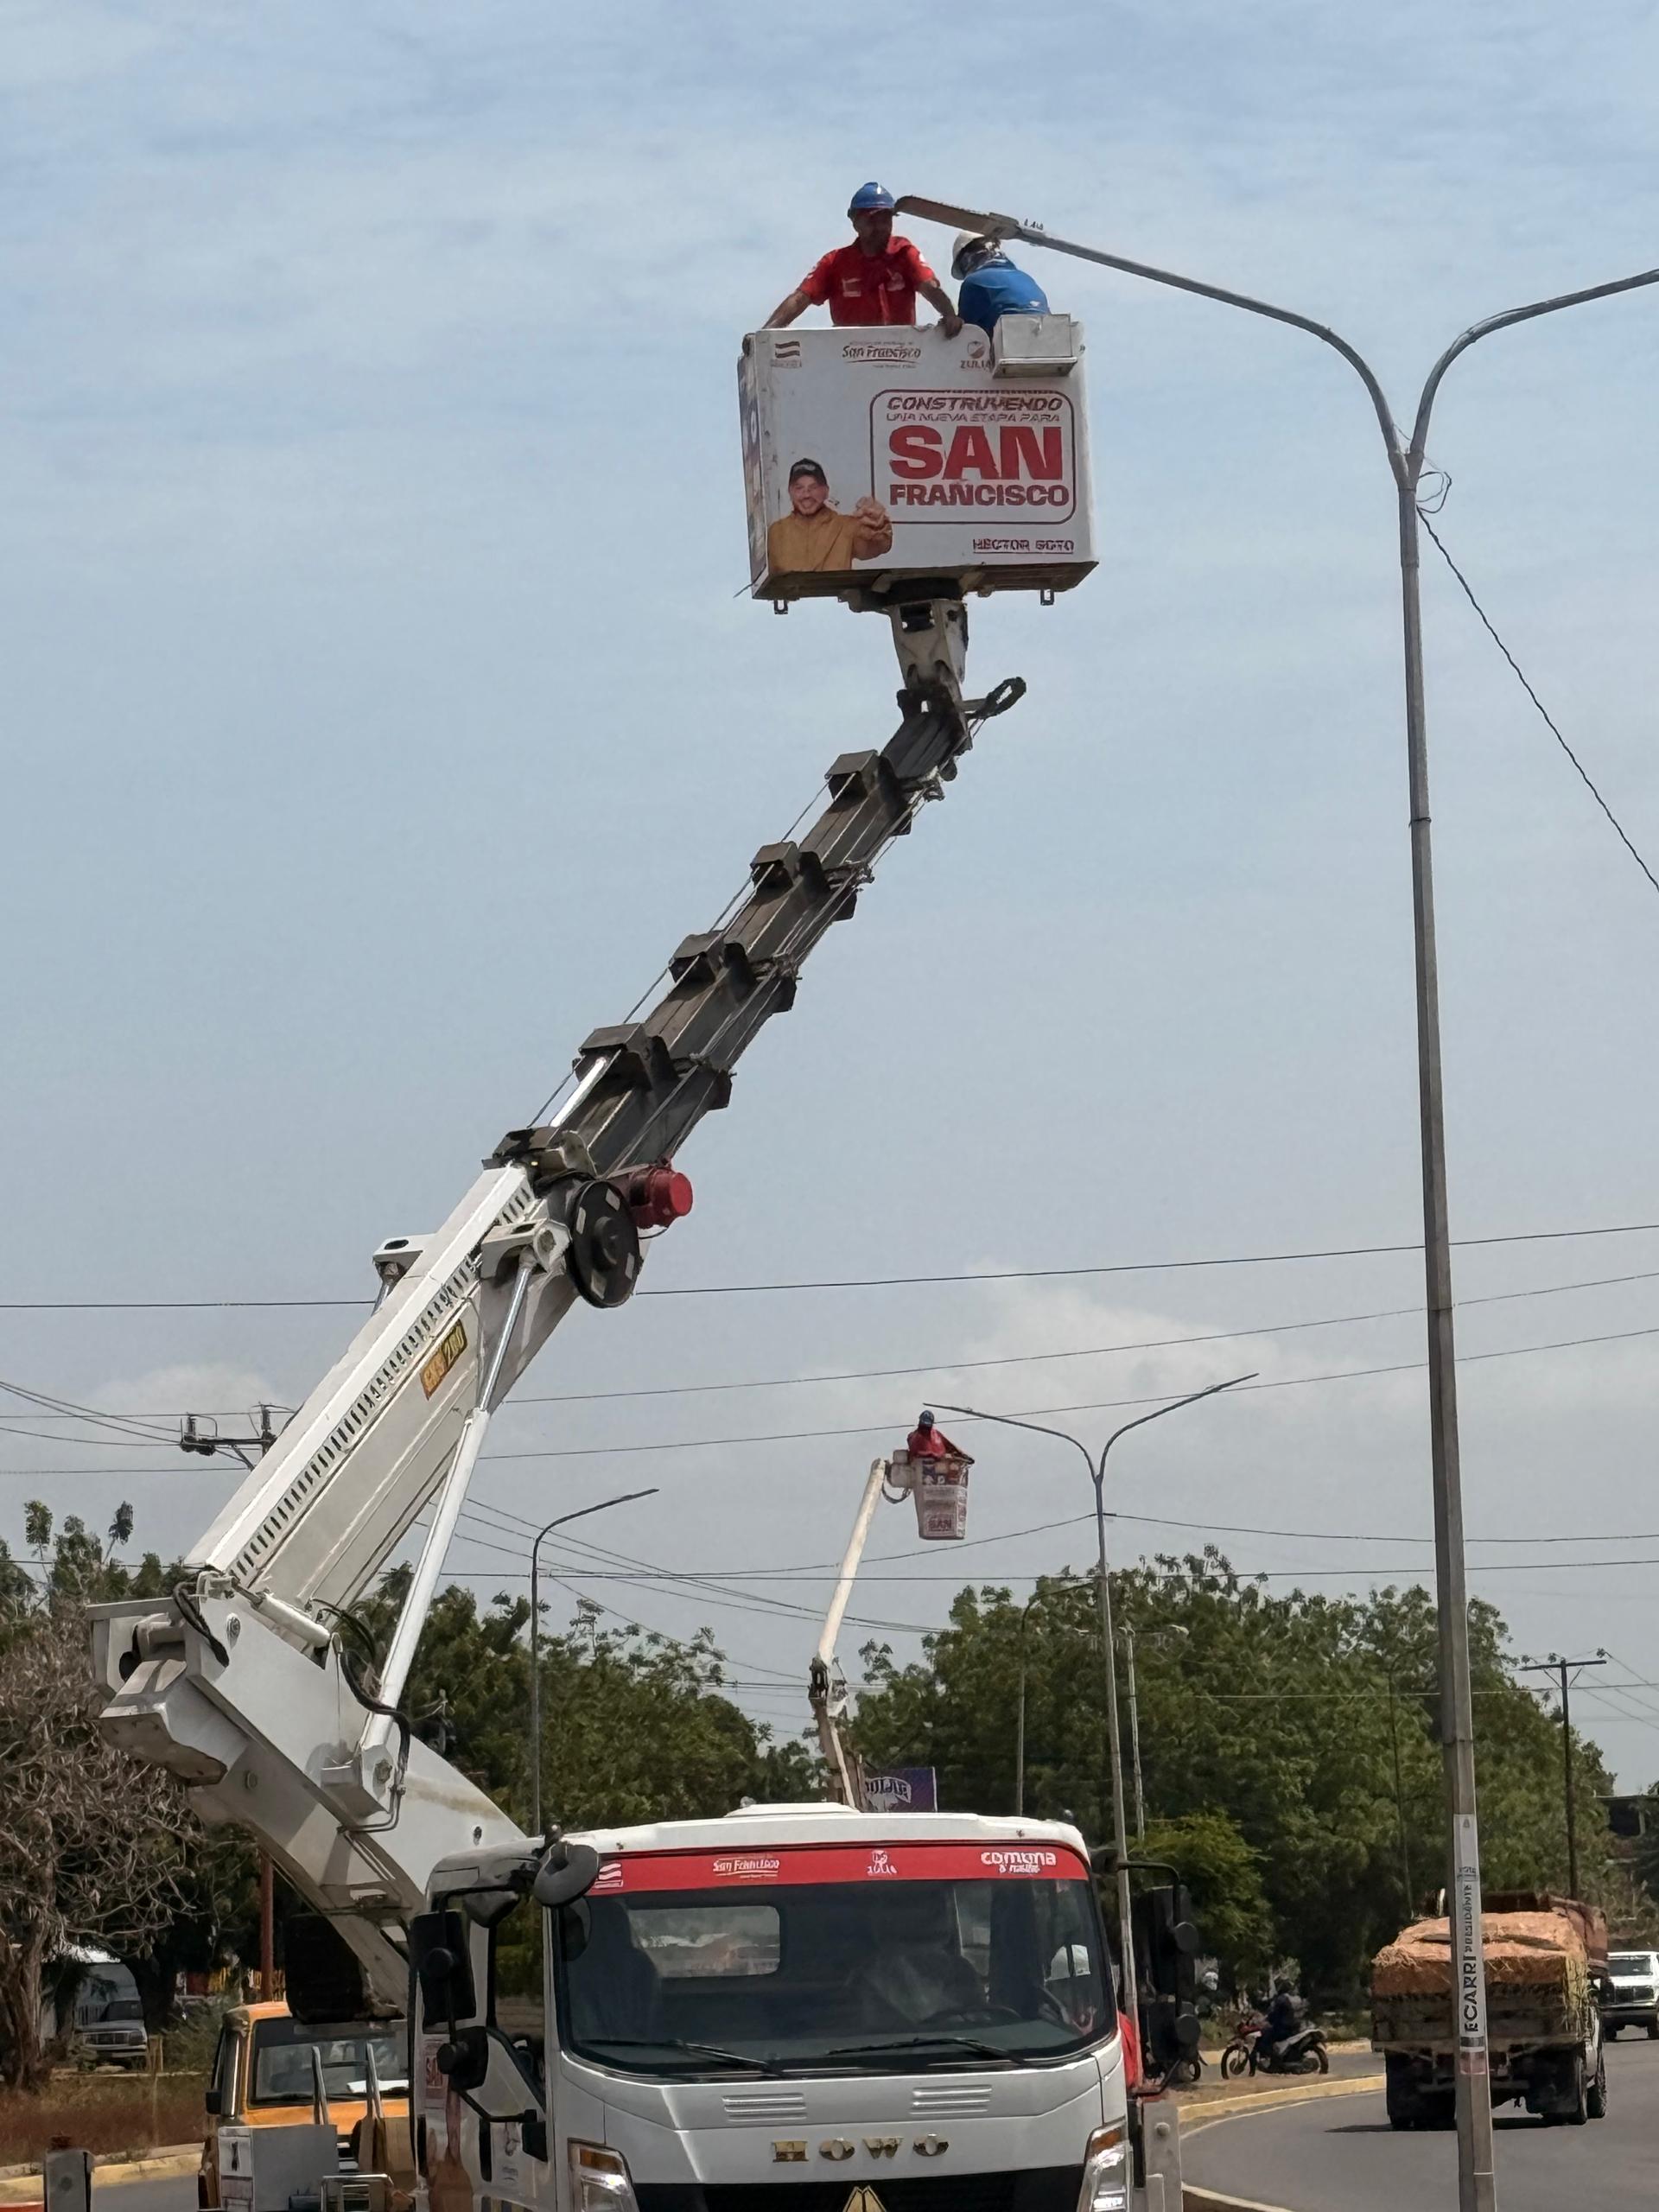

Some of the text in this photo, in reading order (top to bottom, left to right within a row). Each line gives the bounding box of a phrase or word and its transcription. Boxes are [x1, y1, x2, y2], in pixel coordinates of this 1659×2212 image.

[887, 396, 1064, 411] CONSTRUYENDO
[887, 413, 917, 422] UNA
[918, 412, 967, 422] NUEVA
[1019, 414, 1060, 423] PARA
[889, 425, 1063, 480] SAN
[889, 483, 1070, 506] FRANCISCO
[1463, 1955, 1478, 2032] ECARRI
[772, 2133, 950, 2163] HOWO
